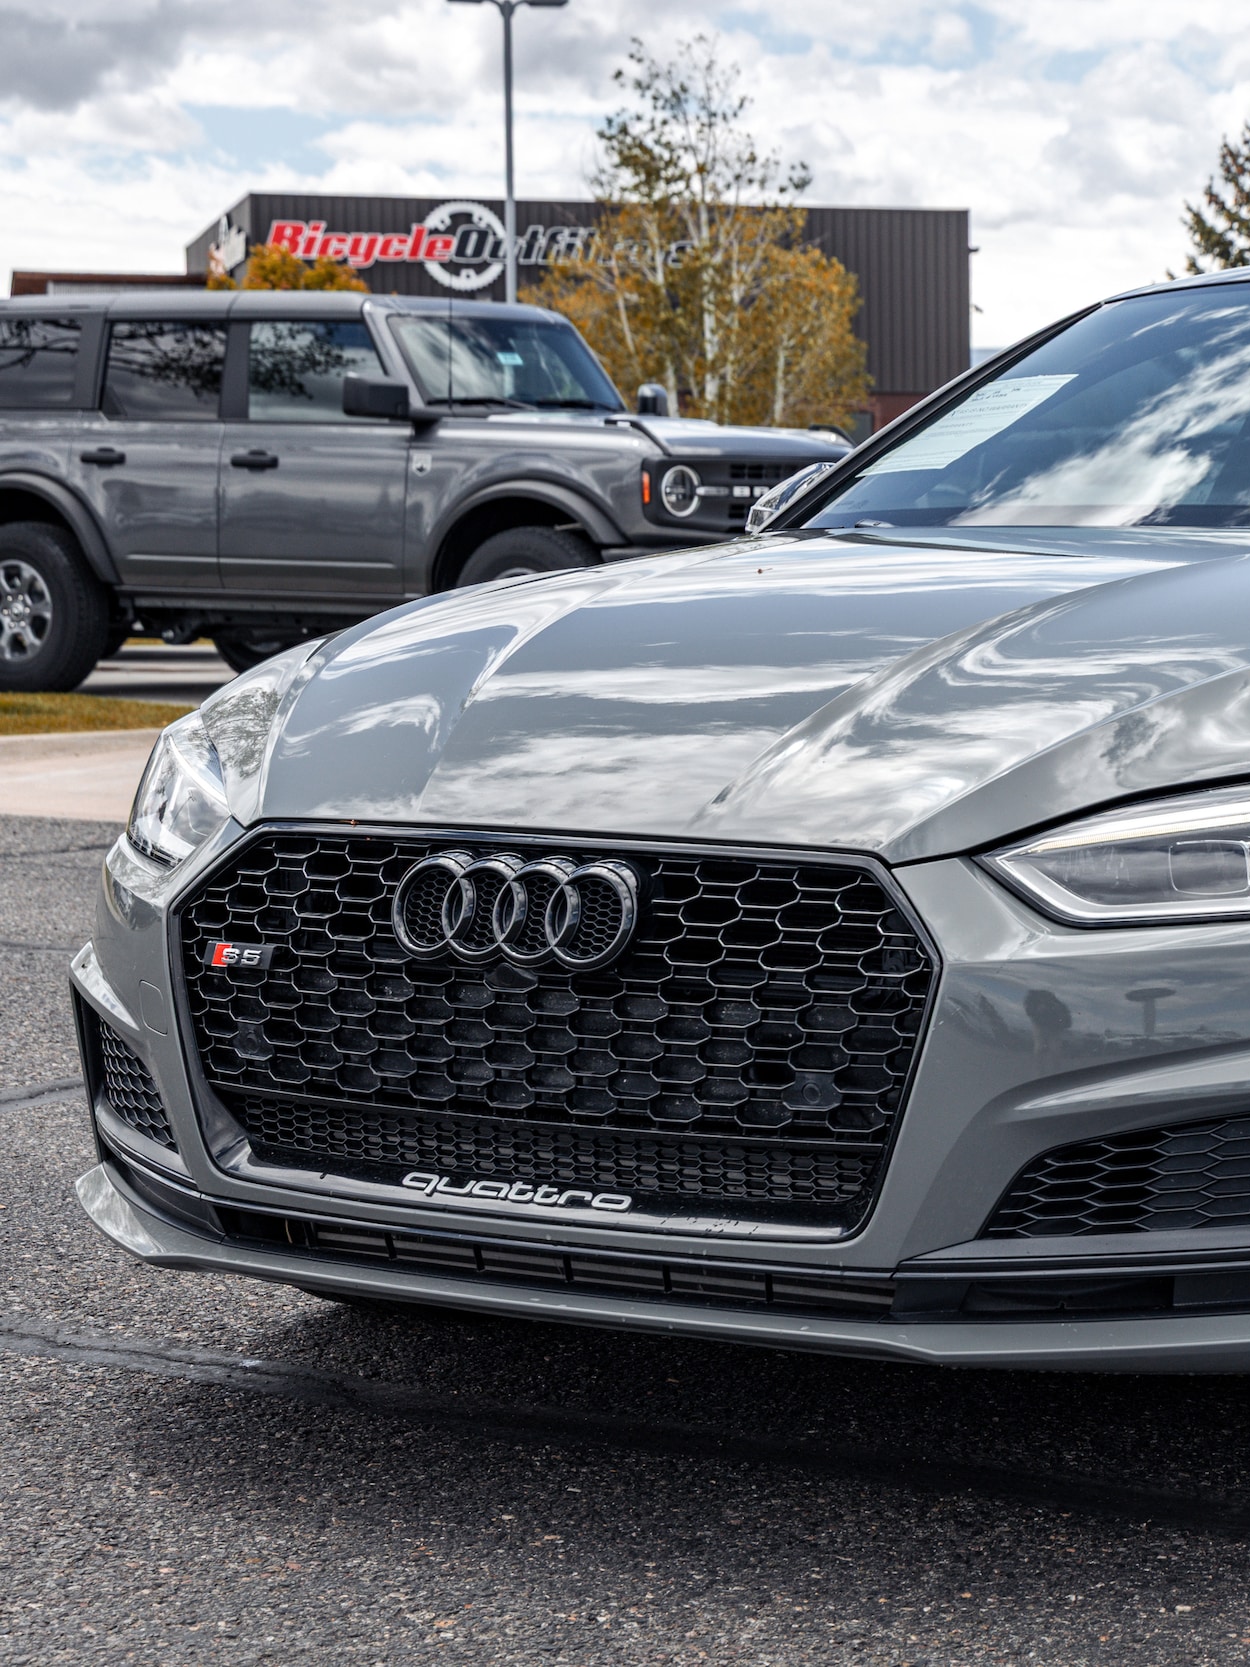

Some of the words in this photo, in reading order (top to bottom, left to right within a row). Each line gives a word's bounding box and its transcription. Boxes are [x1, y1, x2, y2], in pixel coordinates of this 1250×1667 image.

[267, 220, 455, 269] Bicycle
[453, 224, 696, 269] Outfits
[220, 947, 262, 966] S5
[402, 1171, 632, 1211] quattro
